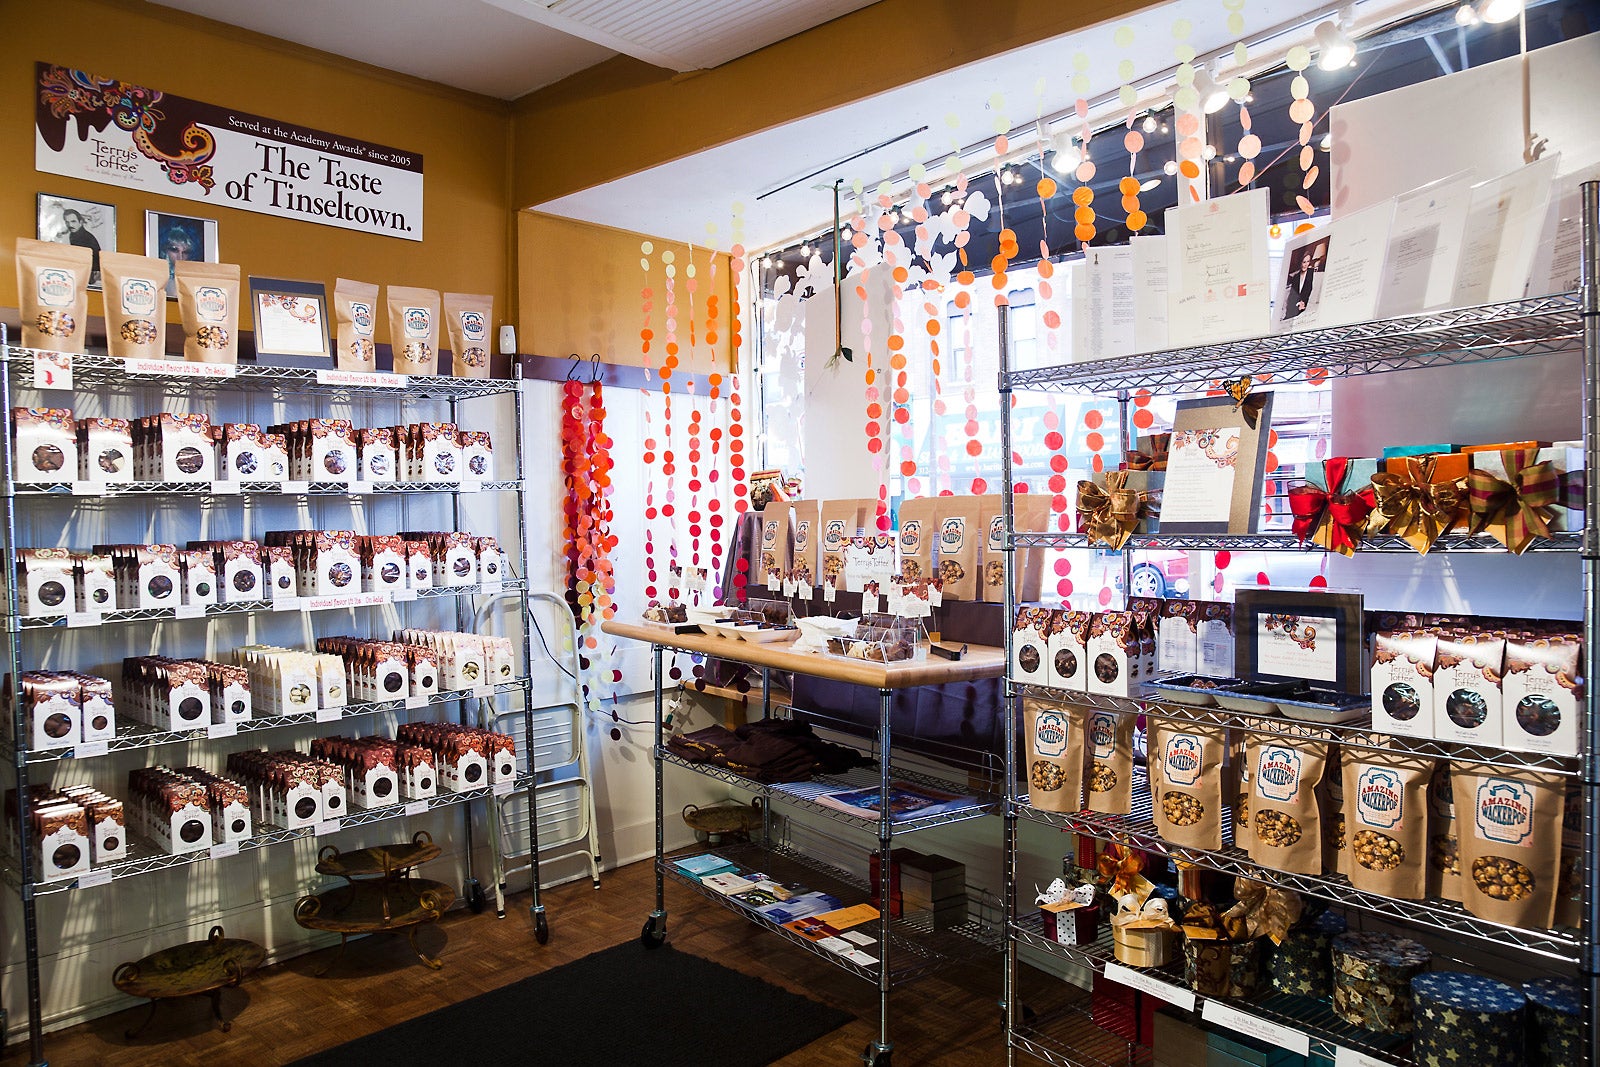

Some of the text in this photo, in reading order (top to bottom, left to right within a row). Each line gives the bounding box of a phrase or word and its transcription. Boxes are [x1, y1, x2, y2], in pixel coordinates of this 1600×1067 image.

[228, 116, 260, 131] Served
[262, 124, 272, 135] at
[274, 124, 288, 138] the
[291, 129, 330, 151] Academy
[368, 148, 389, 162] since
[390, 153, 411, 167] 2005
[91, 138, 138, 163] Terry's
[255, 141, 382, 195] The Taste
[225, 173, 412, 232] of Tinseltown.
[1389, 664, 1415, 675] Terry's
[1453, 669, 1481, 681] Terry's
[1388, 673, 1414, 682] Toffee
[1452, 677, 1480, 687] Toffee
[1523, 674, 1554, 686] Terry's
[1523, 684, 1552, 694] Toffee
[1038, 724, 1065, 736] AMAZING
[1169, 748, 1198, 763] AMAZING
[1262, 762, 1296, 777] AMAZING
[1362, 785, 1399, 803] AMAZING
[1481, 797, 1528, 816] AMAZING
